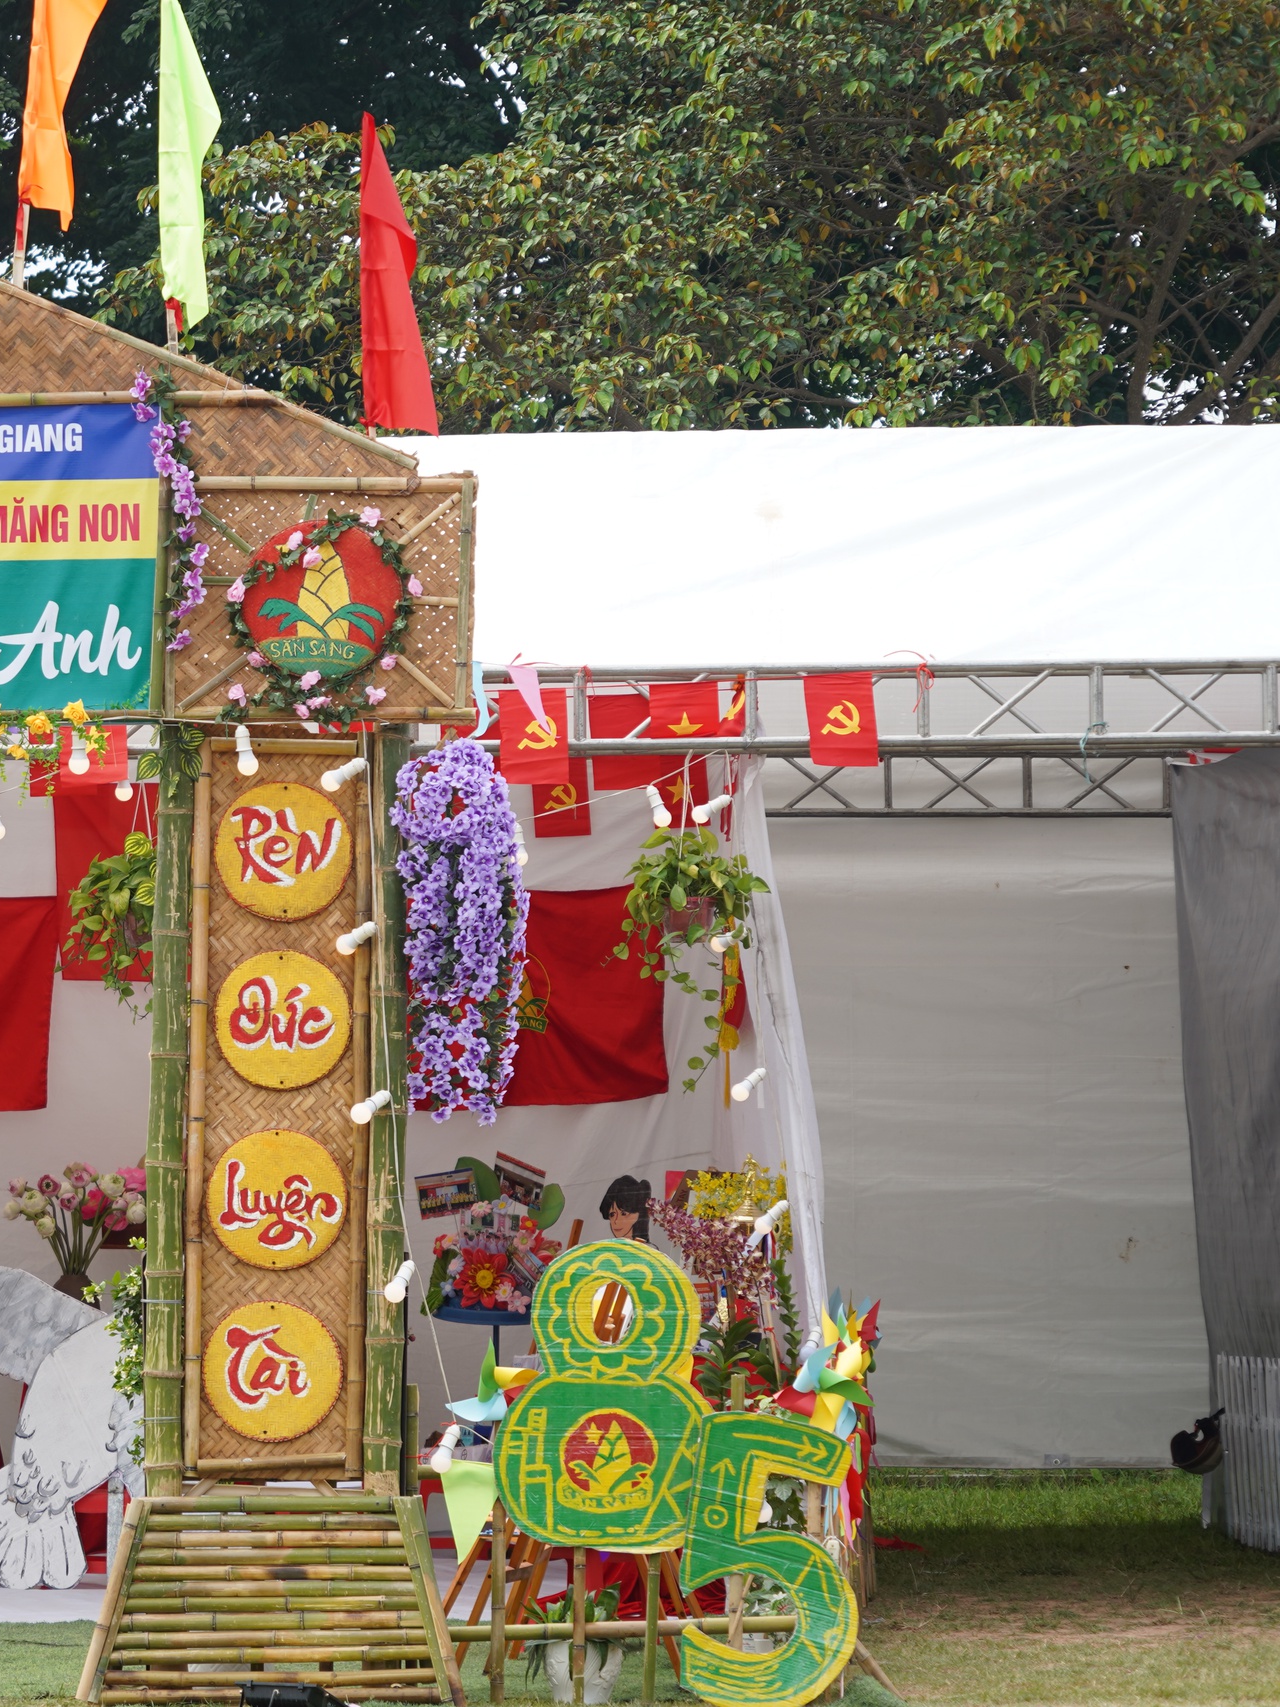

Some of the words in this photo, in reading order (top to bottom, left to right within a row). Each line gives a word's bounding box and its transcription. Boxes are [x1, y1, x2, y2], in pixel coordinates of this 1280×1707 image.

[78, 503, 141, 542] NON
[230, 975, 336, 1053] Đức
[219, 1158, 343, 1251] Luyện
[225, 1324, 311, 1412] Tài
